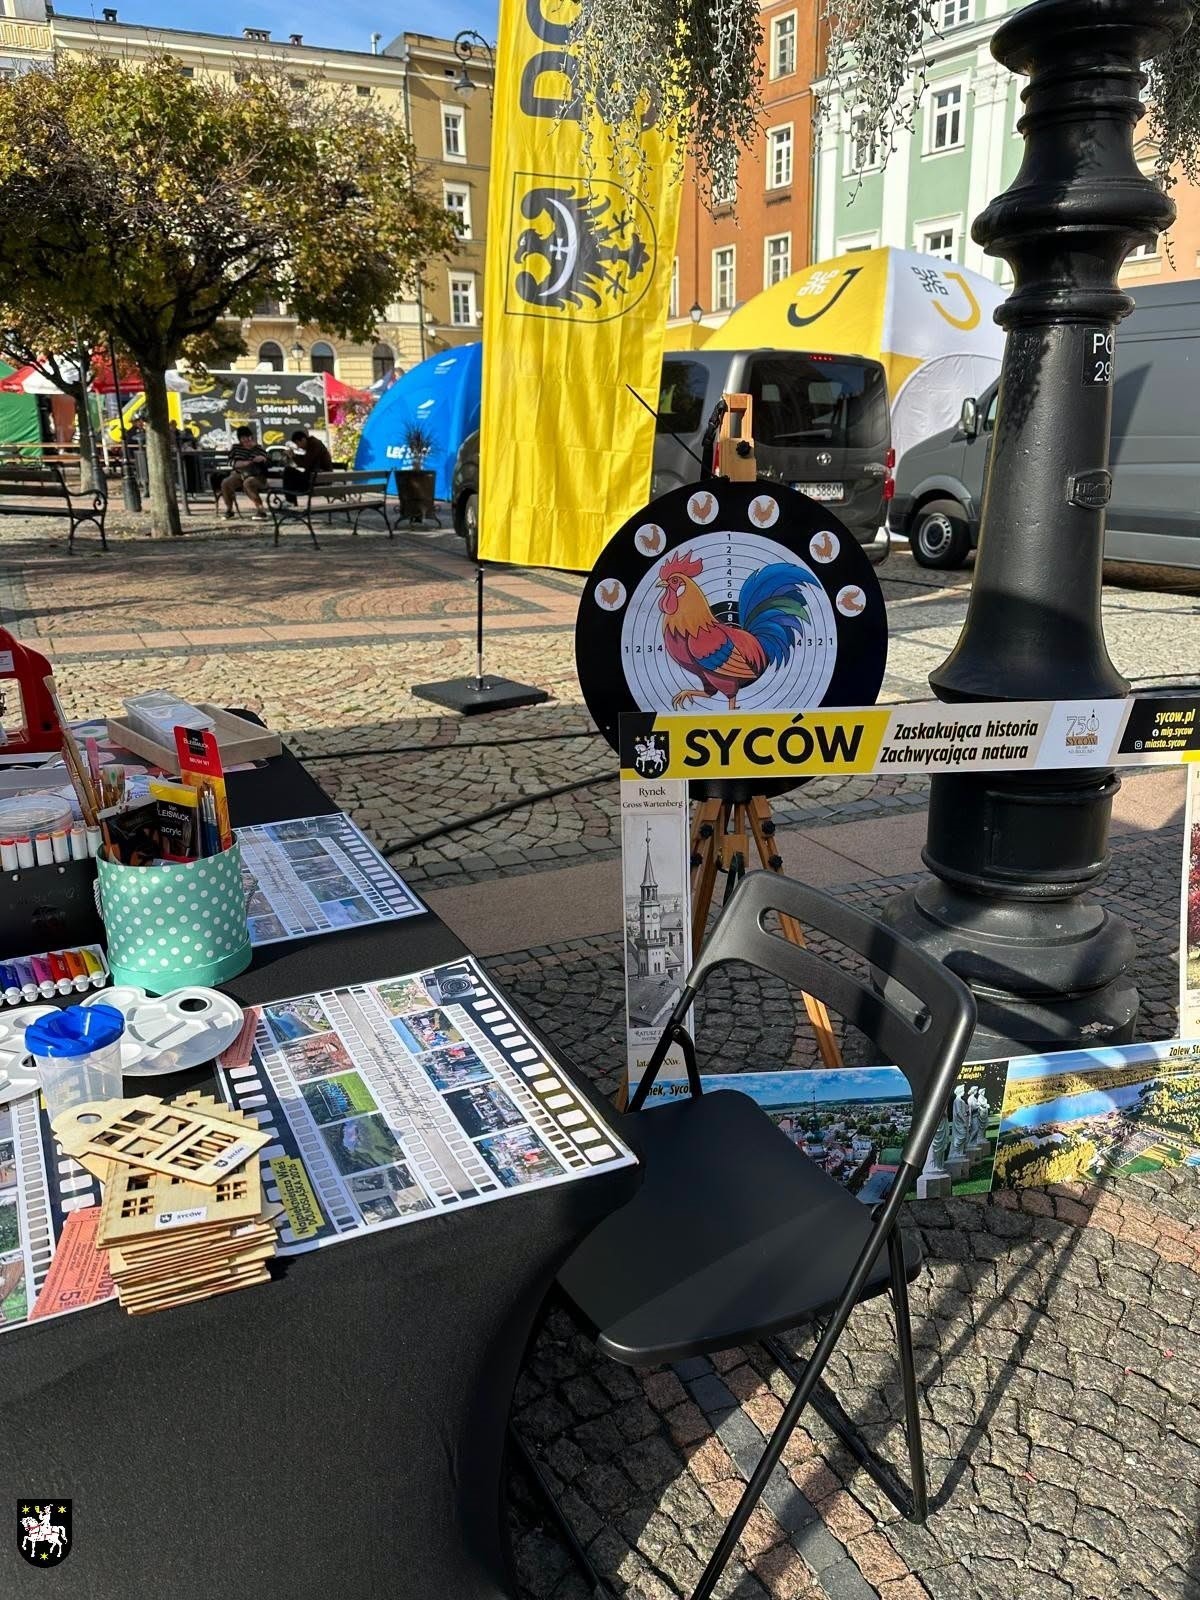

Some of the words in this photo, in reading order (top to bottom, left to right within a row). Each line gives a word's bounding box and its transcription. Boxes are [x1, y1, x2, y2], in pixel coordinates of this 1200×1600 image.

[807, 638, 813, 646] 3
[818, 638, 823, 646] 2
[635, 645, 641, 653] 2
[647, 645, 653, 653] 3
[657, 644, 663, 652] 4
[1154, 709, 1196, 724] sycow.pl
[893, 722, 982, 742] Zaskakująca
[986, 719, 1039, 737] historia
[1161, 727, 1194, 738] mig.sycow
[683, 712, 865, 767] SYCÓW
[1144, 738, 1187, 749] miasto.sycow
[880, 745, 978, 765] Zachwycająca
[981, 745, 1029, 760] natura
[639, 786, 667, 797] Rynek
[643, 799, 684, 808] Wartenberg
[1169, 1046, 1191, 1056] Zalew
